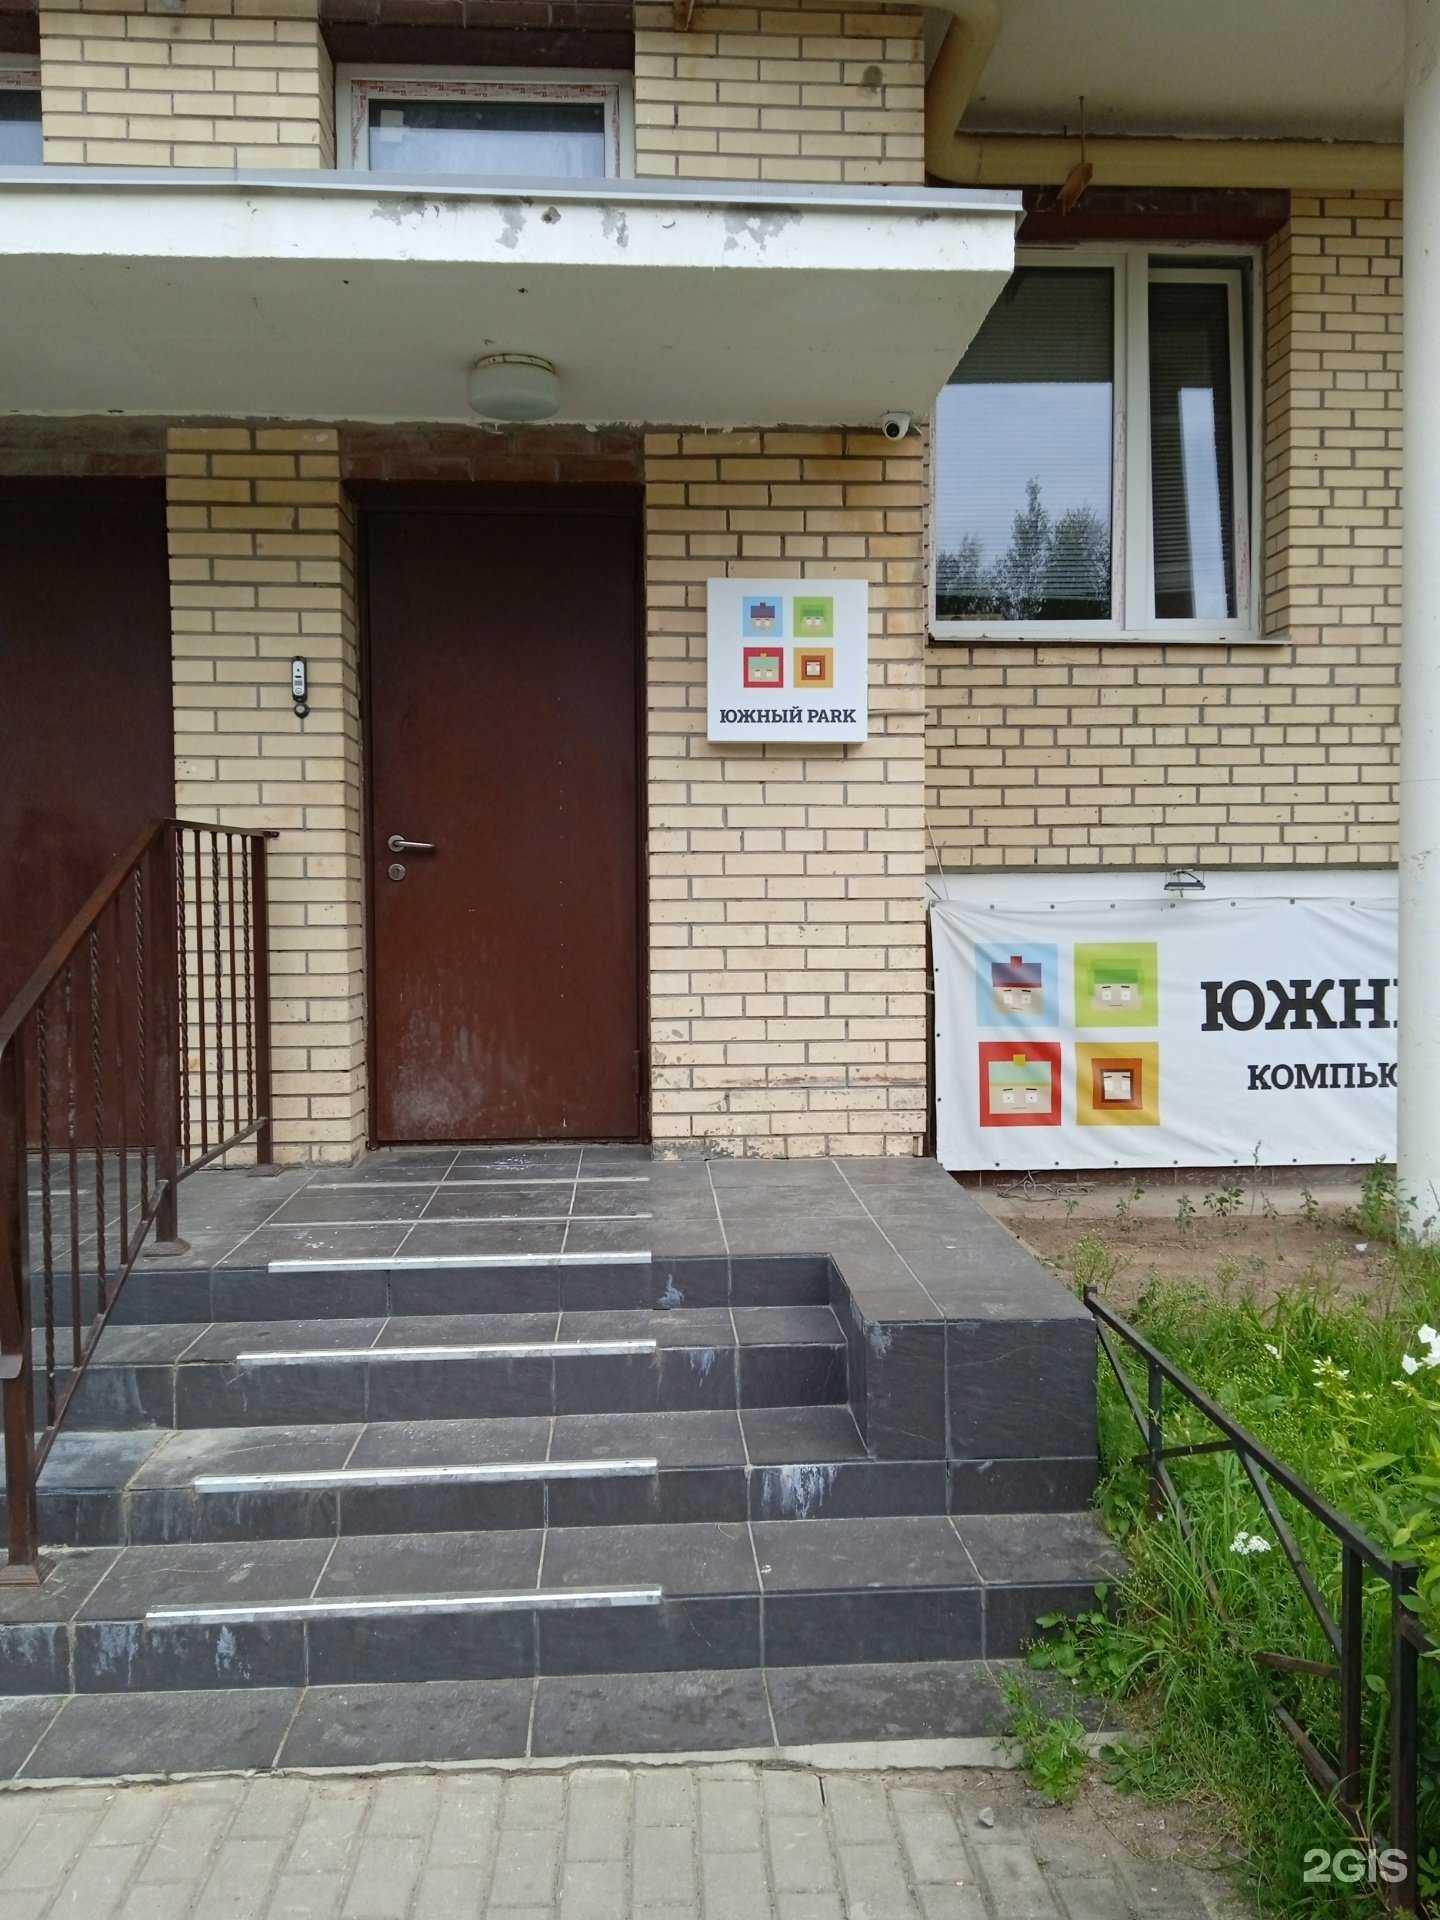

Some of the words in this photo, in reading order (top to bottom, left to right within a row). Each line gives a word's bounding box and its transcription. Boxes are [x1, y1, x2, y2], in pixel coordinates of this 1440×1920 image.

[719, 706, 803, 724] ЮЖНЫЙ
[807, 709, 857, 724] PARK
[1200, 978, 1398, 1032] ЮЖН
